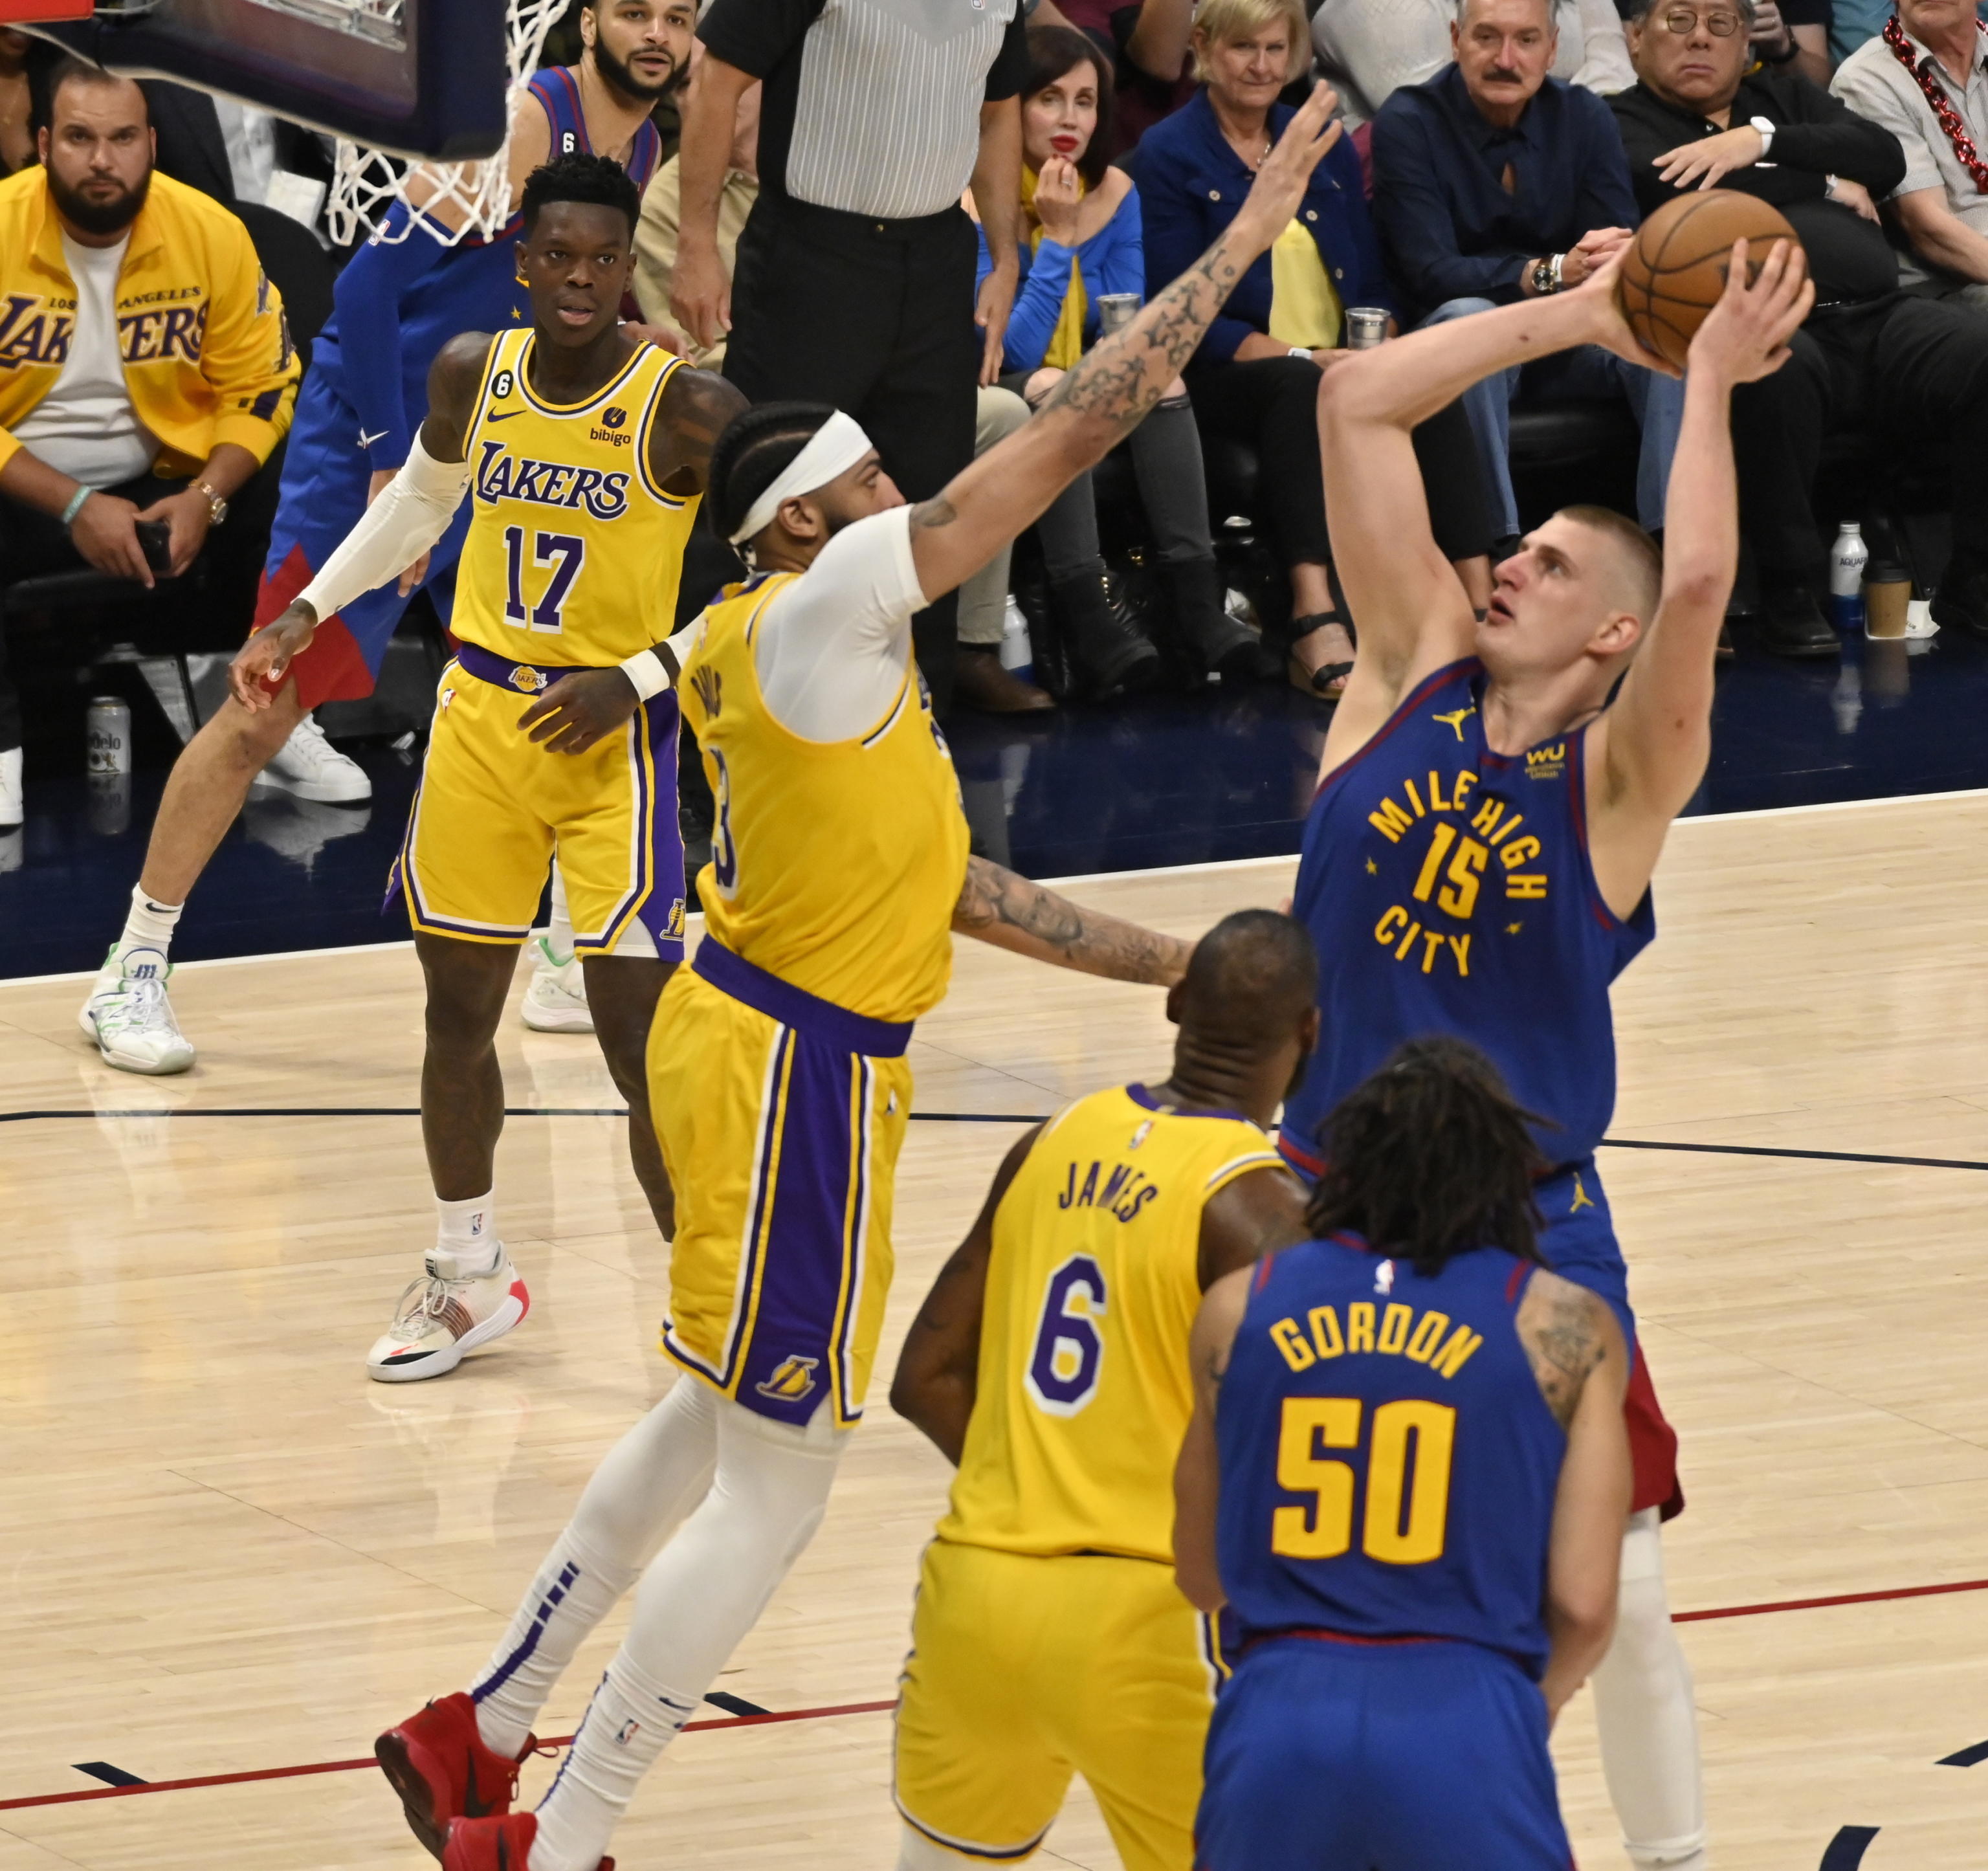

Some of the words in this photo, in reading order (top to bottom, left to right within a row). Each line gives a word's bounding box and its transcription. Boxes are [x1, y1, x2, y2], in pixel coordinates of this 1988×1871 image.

[563, 132, 575, 153] 6
[49, 297, 78, 310] LOS
[118, 286, 201, 309] ANGELES
[496, 373, 510, 396] 6
[590, 428, 631, 447] bibigo
[476, 440, 630, 520] LAKERS
[503, 524, 585, 634] 17
[510, 669, 545, 687] LAKERS
[1527, 742, 1565, 765] WU
[1367, 769, 1479, 843] MILE
[1470, 797, 1548, 899] HIGH
[1412, 821, 1489, 920] 15
[1374, 905, 1472, 976] CITY
[1059, 1161, 1158, 1223] JAMES
[1024, 1252, 1107, 1417] 6
[1269, 1301, 1483, 1379] GORDON
[1271, 1396, 1457, 1565] 50
